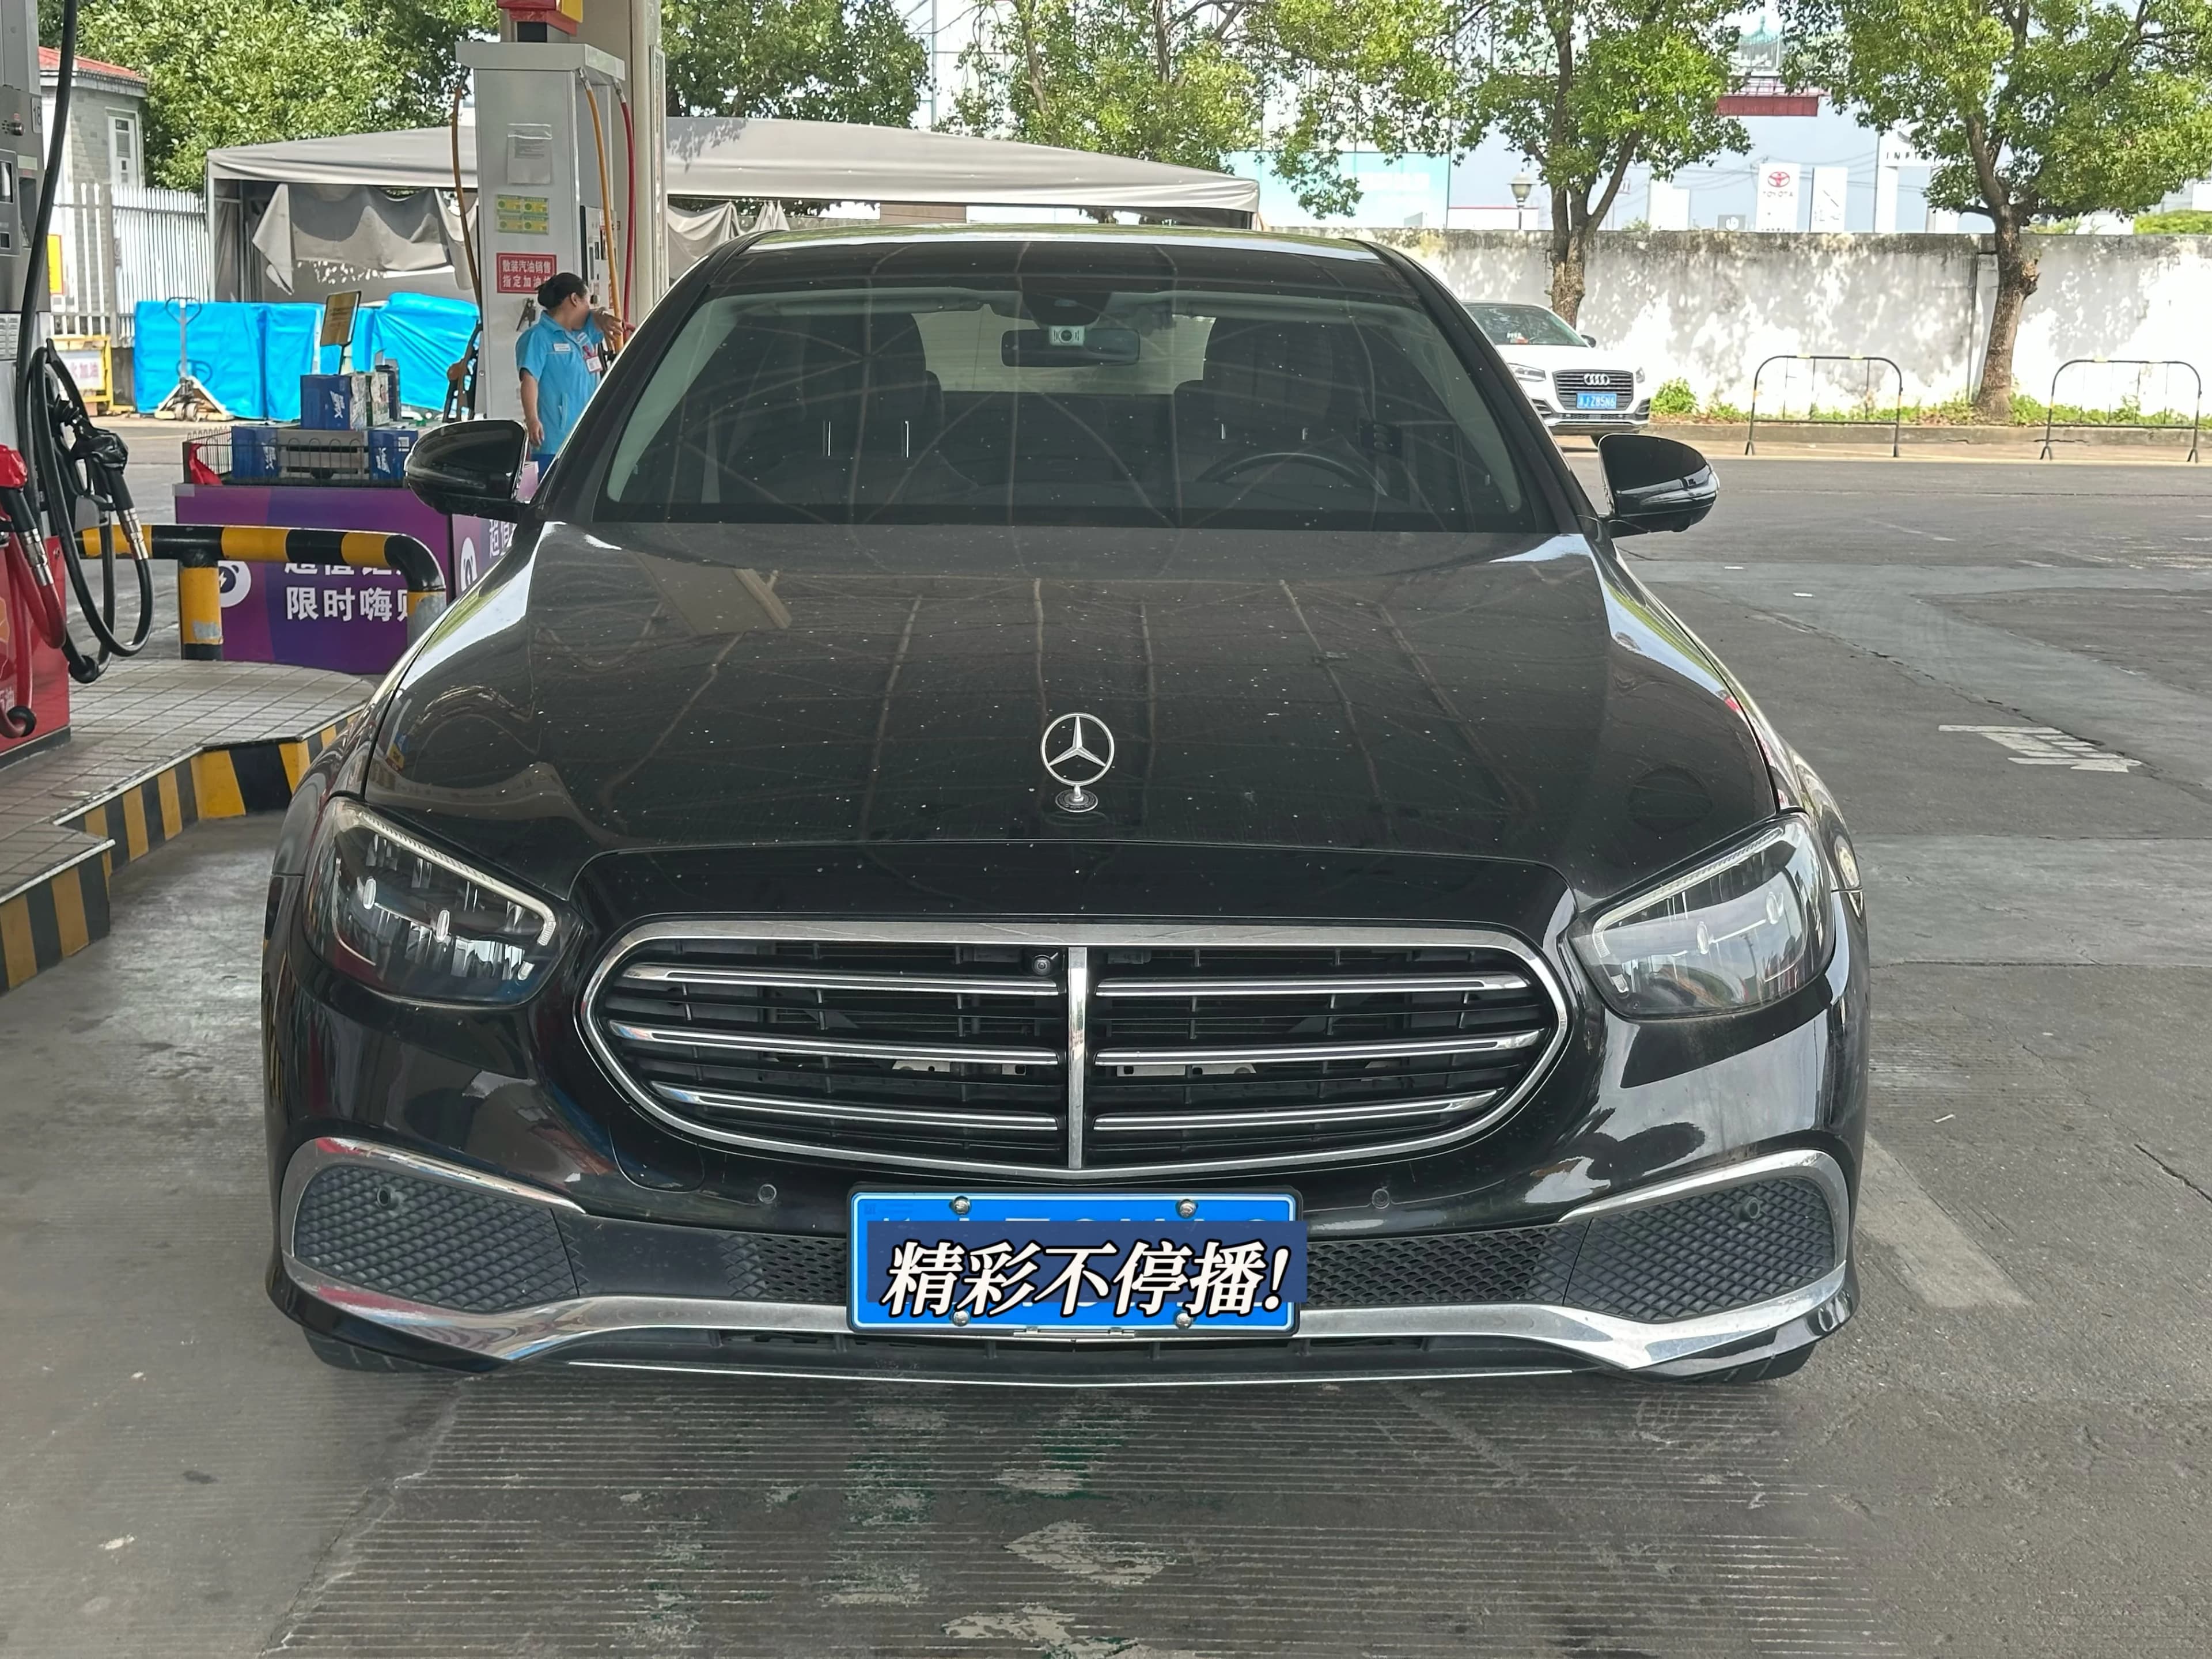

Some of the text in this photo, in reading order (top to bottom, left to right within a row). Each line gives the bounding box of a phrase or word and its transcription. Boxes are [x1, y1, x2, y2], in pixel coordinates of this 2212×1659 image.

[33, 106, 42, 126] 18
[502, 259, 551, 274] 散装汽油销售
